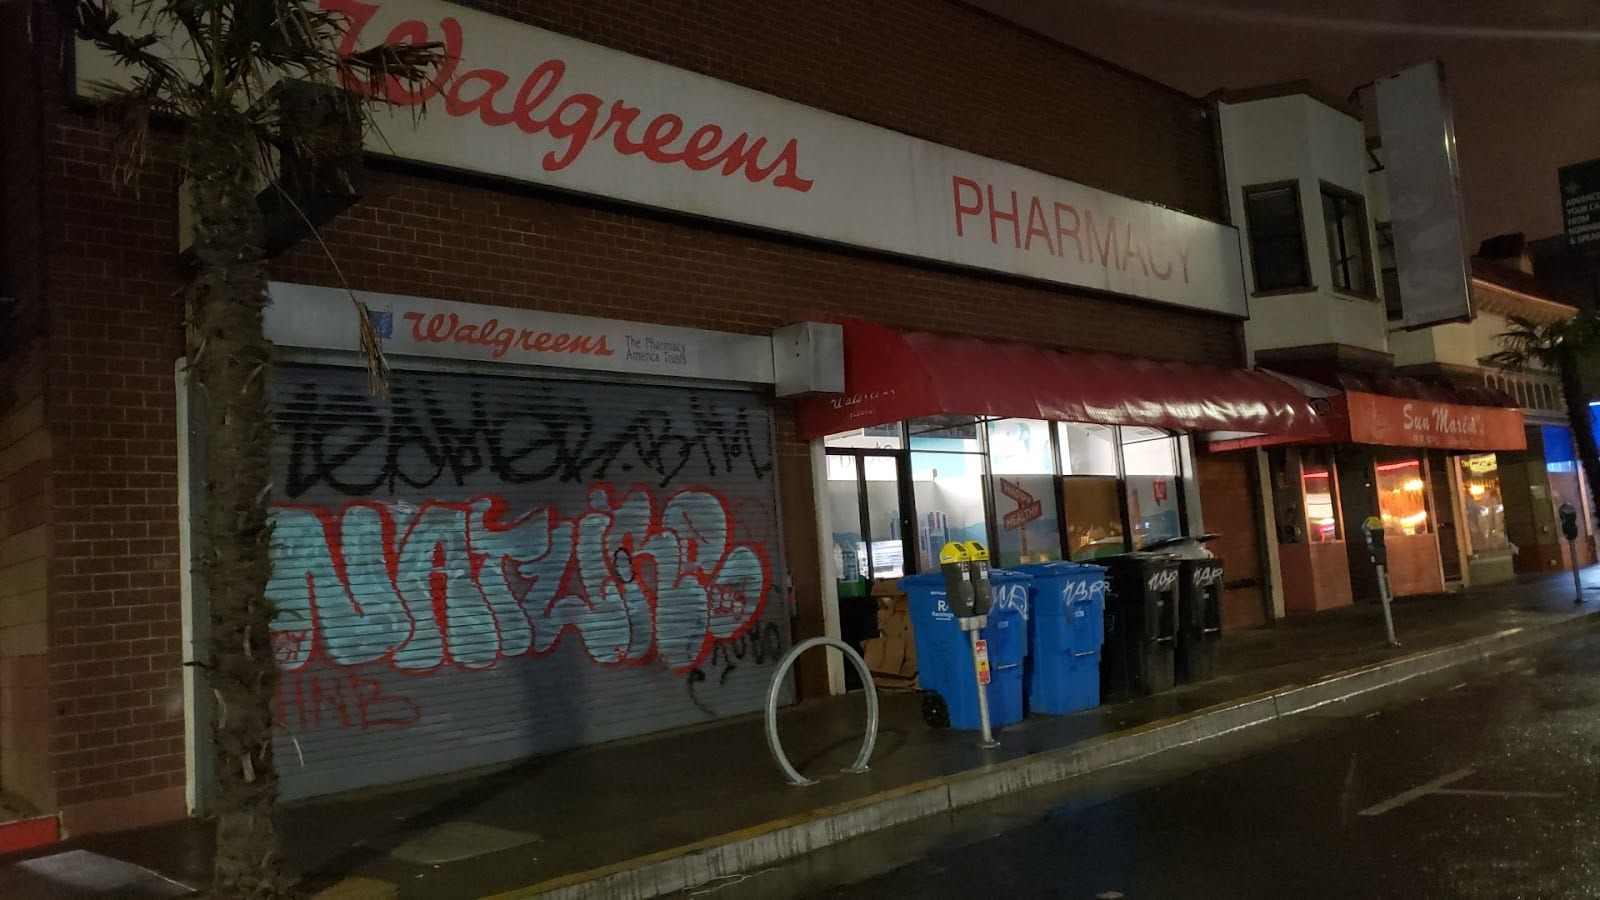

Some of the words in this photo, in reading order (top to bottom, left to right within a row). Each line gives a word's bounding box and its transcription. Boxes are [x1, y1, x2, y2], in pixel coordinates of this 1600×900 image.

[319, 0, 814, 192] Walgreens
[953, 175, 1193, 284] PHARMACY
[1568, 214, 1590, 225] FROM
[403, 311, 615, 358] Walgreens
[625, 335, 641, 349] The
[645, 337, 687, 353] Pharmacy
[626, 348, 660, 362] America
[1403, 403, 1430, 431] Sun
